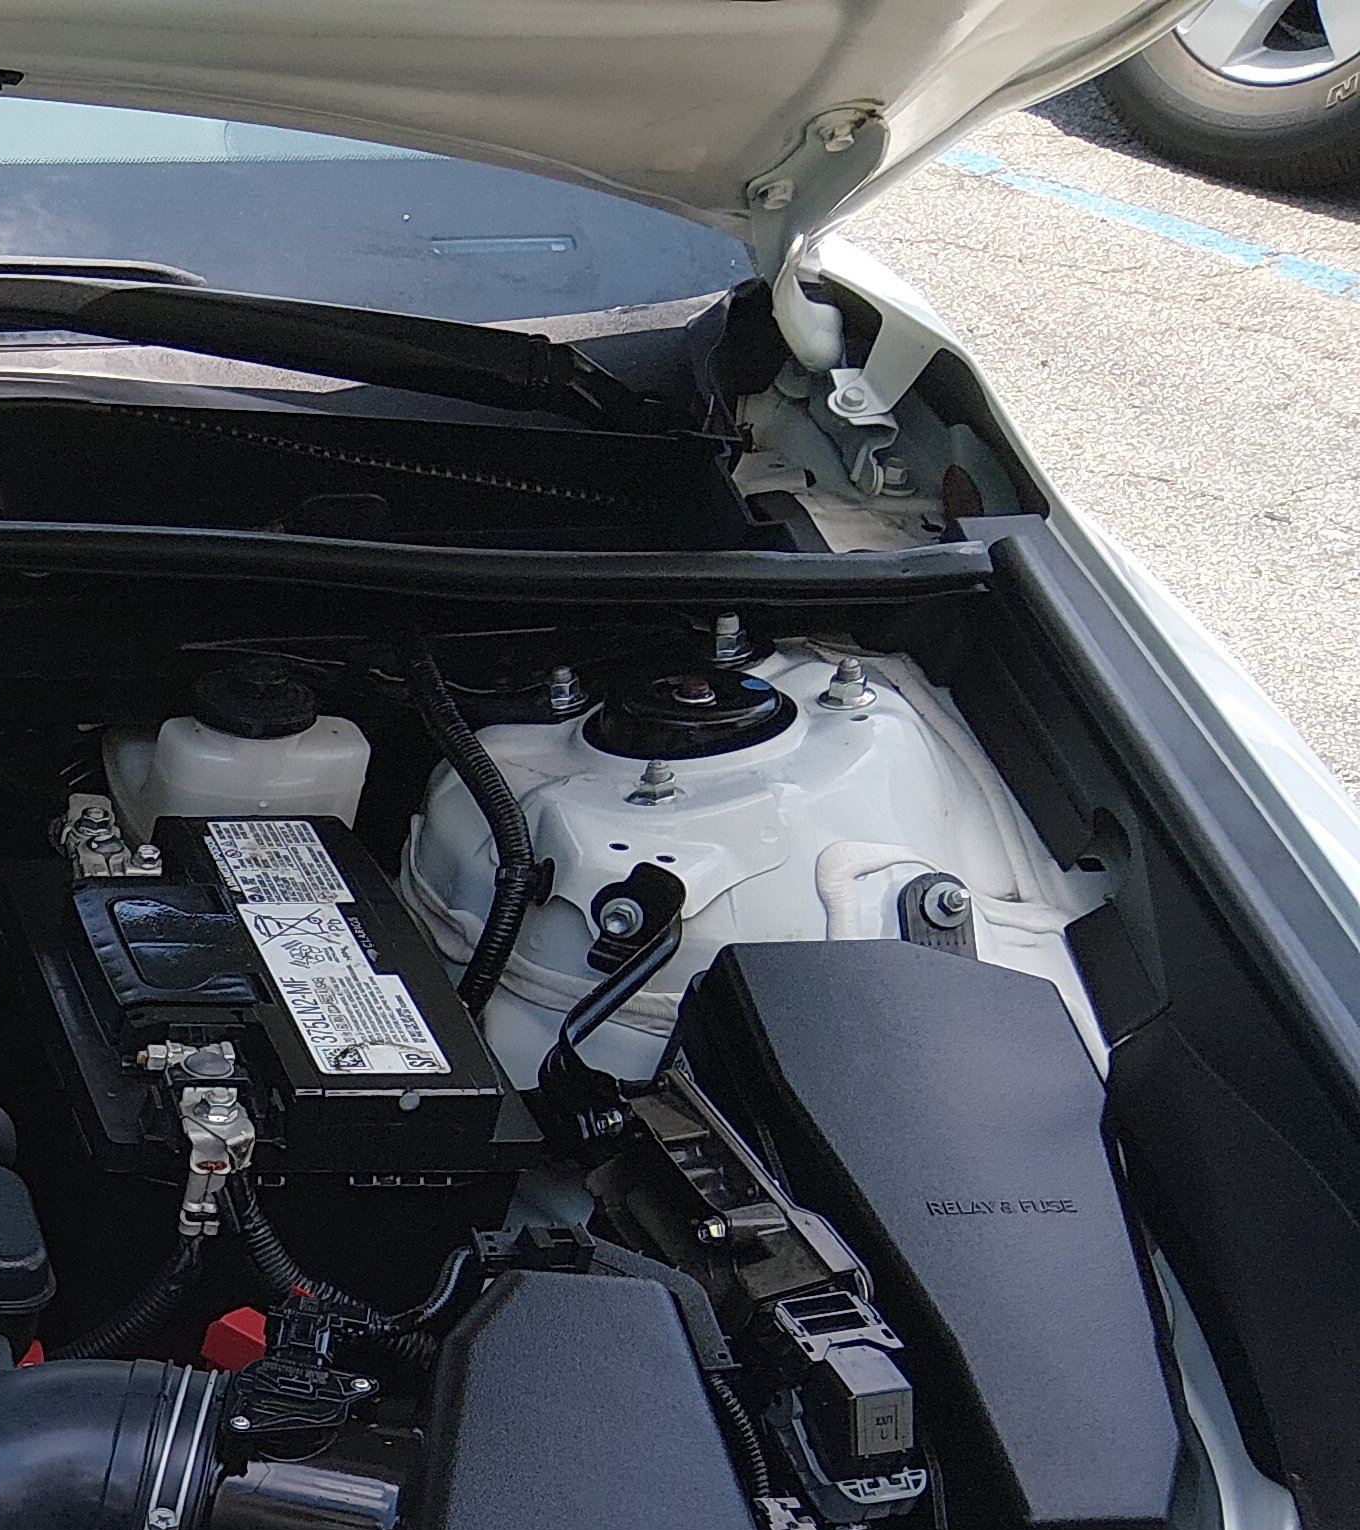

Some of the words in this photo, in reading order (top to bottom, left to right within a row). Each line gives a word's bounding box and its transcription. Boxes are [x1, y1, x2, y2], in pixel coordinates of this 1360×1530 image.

[278, 976, 336, 1044] 375LN2-MF
[407, 1052, 437, 1068] SP
[926, 1200, 994, 1216] RELAY
[1000, 1201, 1014, 1214] &
[1018, 1199, 1078, 1214] FUSE
